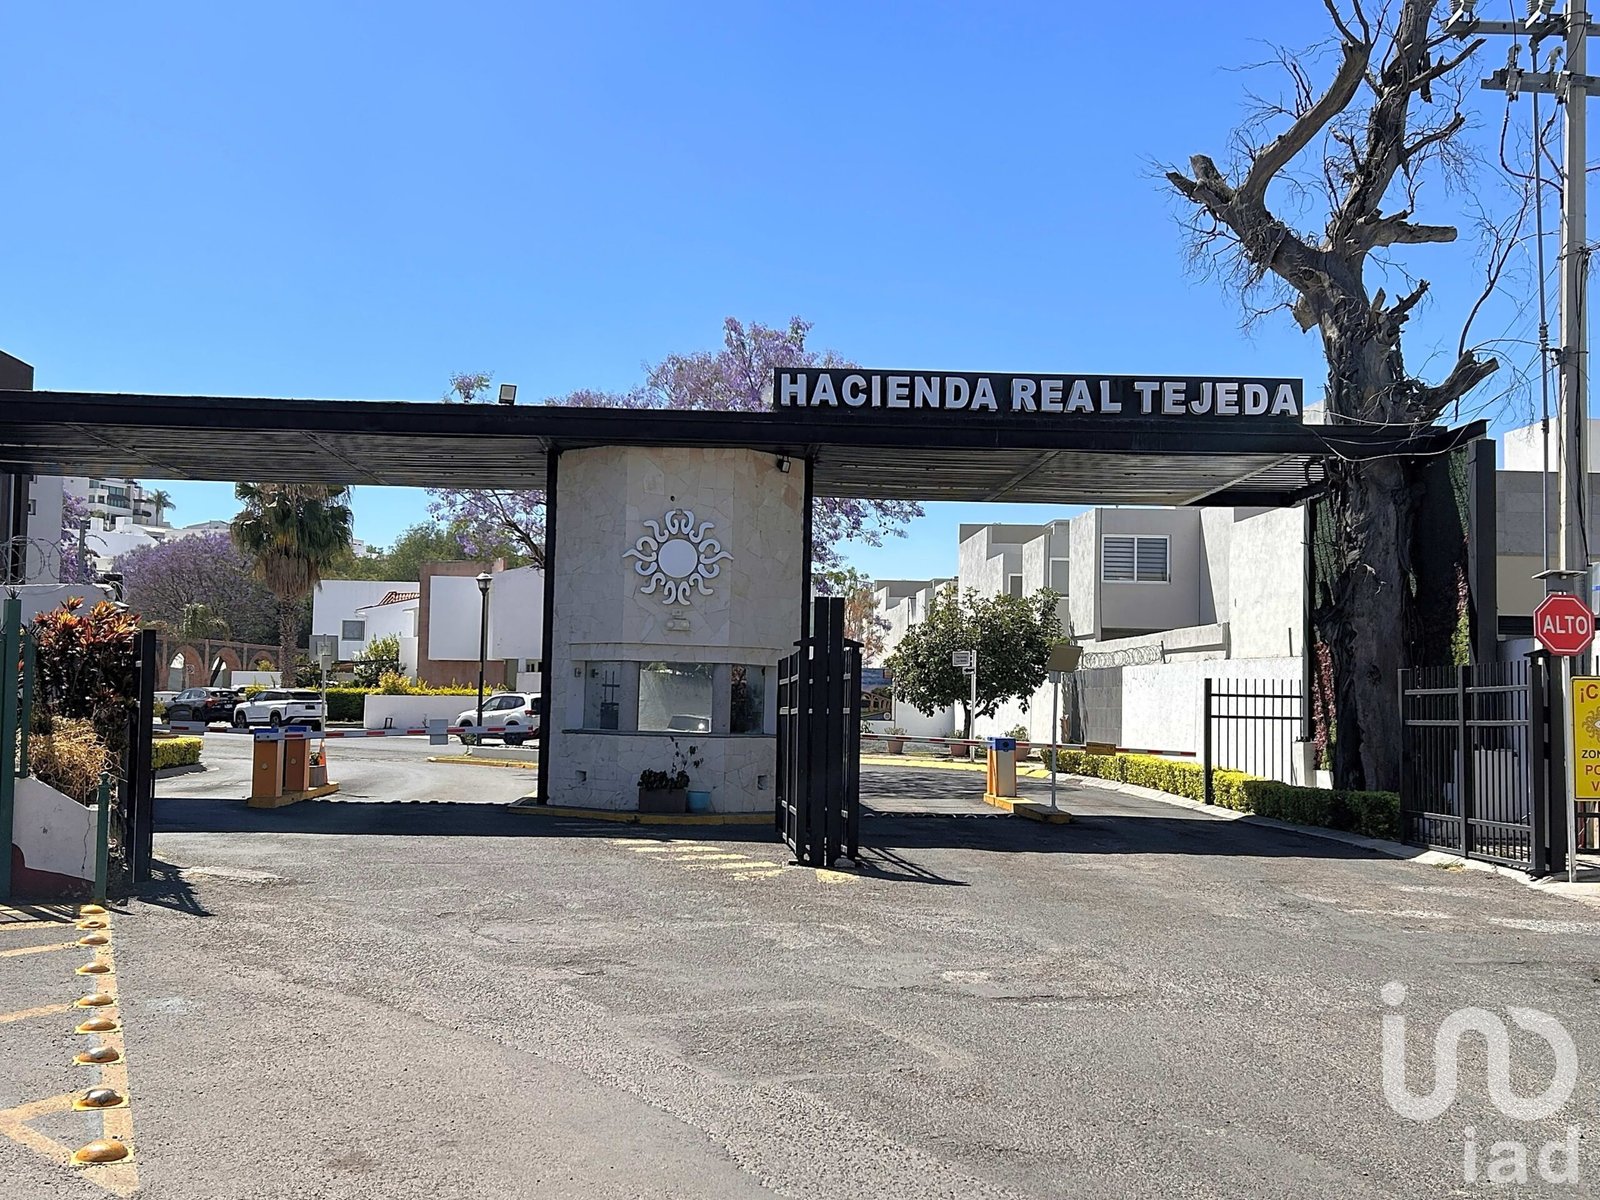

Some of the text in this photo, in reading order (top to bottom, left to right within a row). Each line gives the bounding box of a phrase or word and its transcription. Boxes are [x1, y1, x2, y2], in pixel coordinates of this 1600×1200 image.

[780, 372, 1299, 417] HACIENDA REAL TEJEDA
[1542, 614, 1588, 635] ALTO
